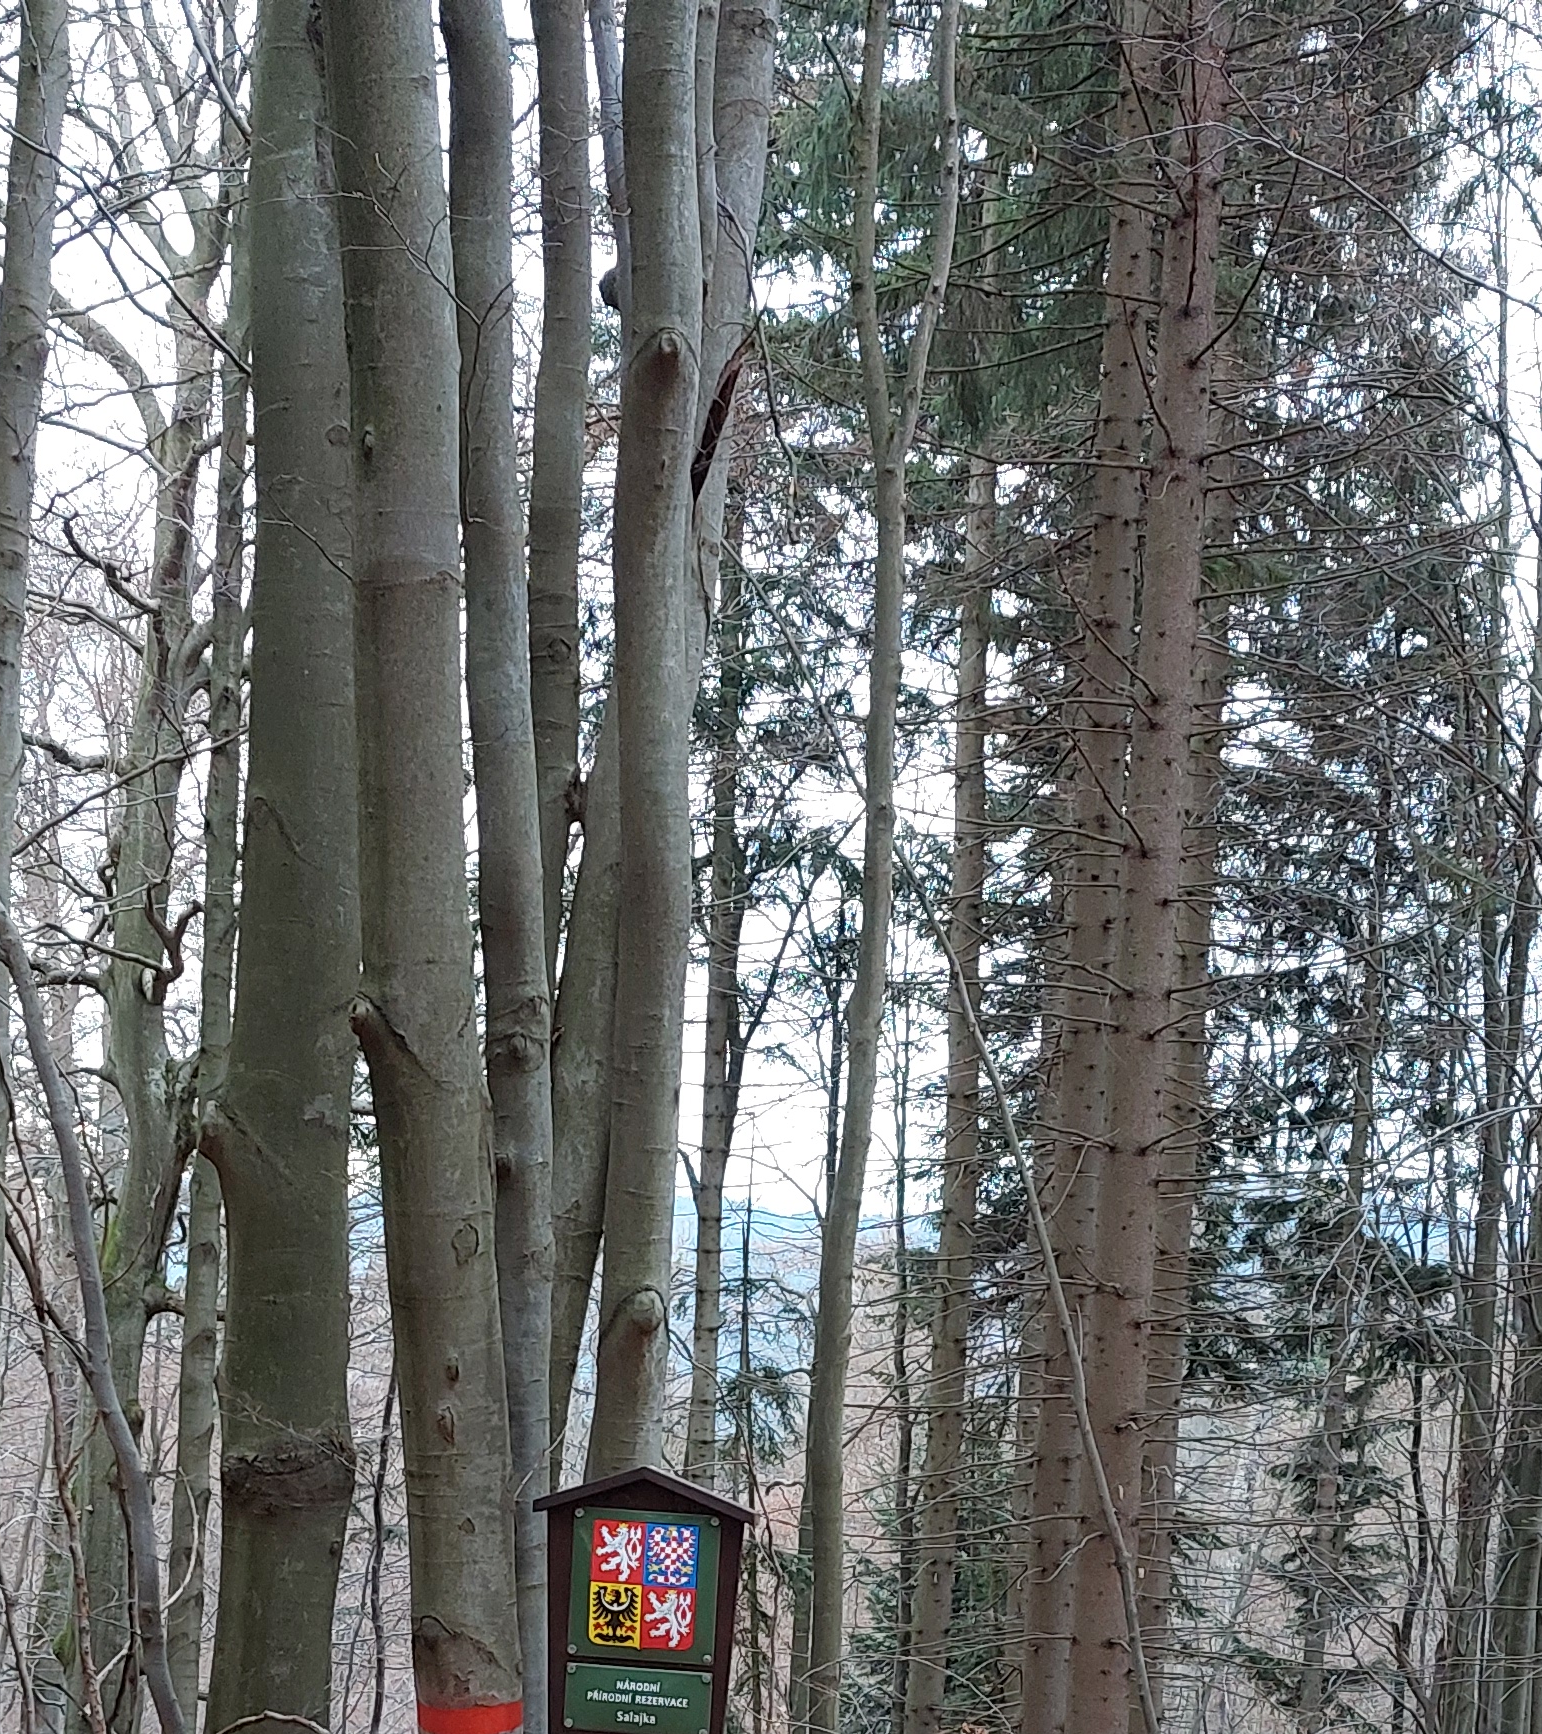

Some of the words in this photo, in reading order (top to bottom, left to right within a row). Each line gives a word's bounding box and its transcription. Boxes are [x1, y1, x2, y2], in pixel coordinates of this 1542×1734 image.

[616, 1677, 661, 1693] NÁRODNÍ
[586, 1689, 632, 1703] PŘÍRODNÍ
[635, 1695, 689, 1708] REZERVACE
[616, 1710, 656, 1727] Salajka
